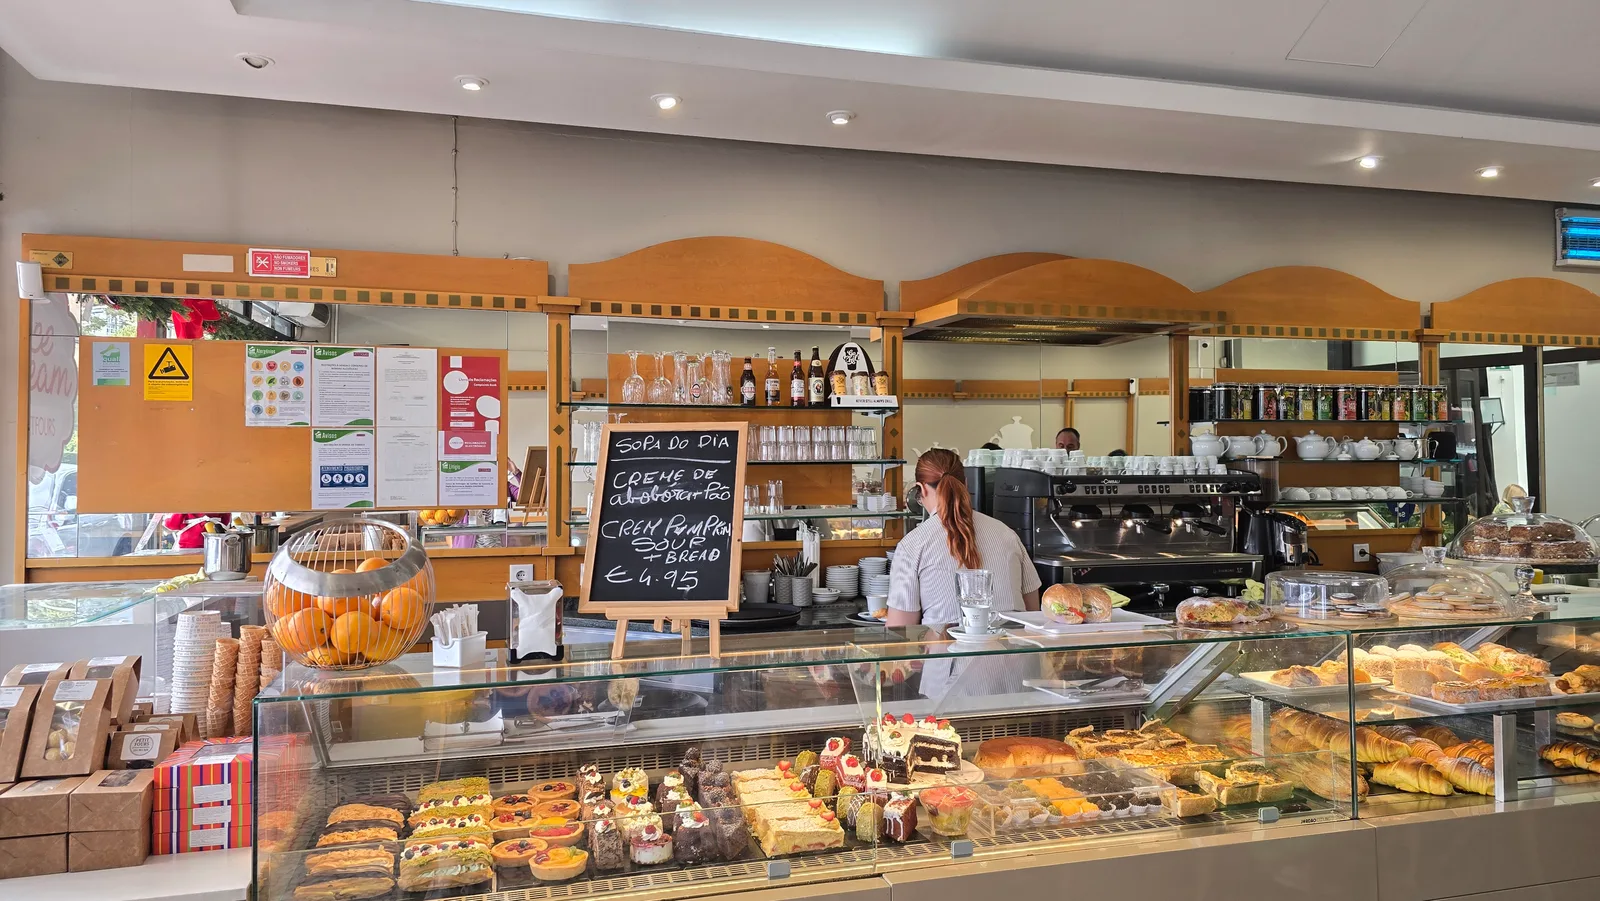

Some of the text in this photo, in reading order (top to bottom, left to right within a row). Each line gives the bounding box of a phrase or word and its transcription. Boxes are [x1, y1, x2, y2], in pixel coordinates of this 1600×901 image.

[322, 348, 338, 356] Avisos
[615, 435, 661, 454] SOPA
[667, 436, 689, 450] DO
[613, 469, 718, 489] CREME DE
[601, 517, 663, 539] CREM
[664, 548, 721, 565] BREAD
[639, 567, 699, 590] 4.95
